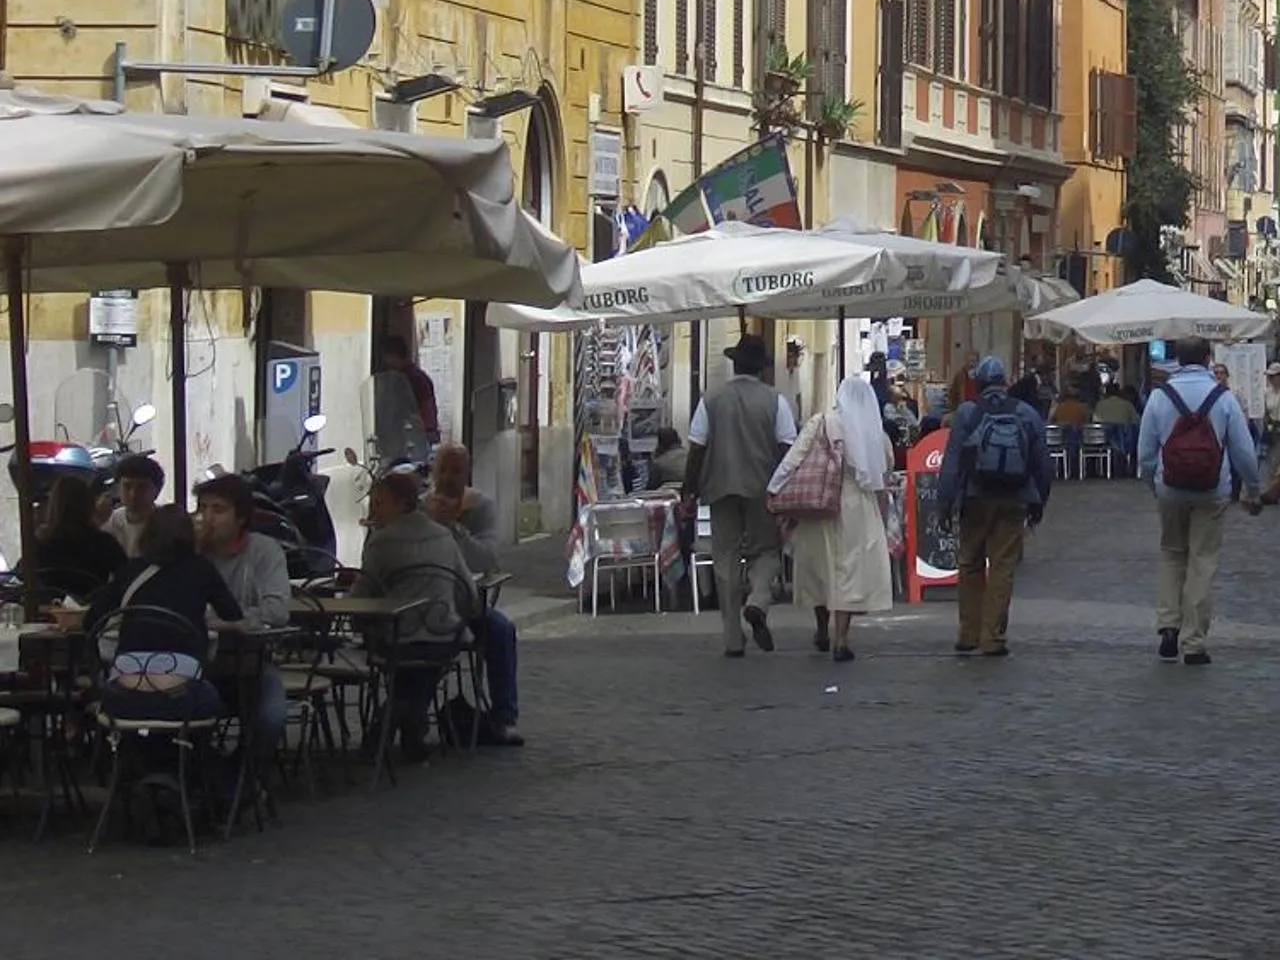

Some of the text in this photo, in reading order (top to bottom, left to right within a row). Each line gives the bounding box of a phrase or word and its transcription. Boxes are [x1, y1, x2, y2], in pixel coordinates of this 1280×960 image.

[742, 271, 814, 293] TUBORG
[582, 286, 649, 310] TUBORG
[276, 363, 291, 389] P
